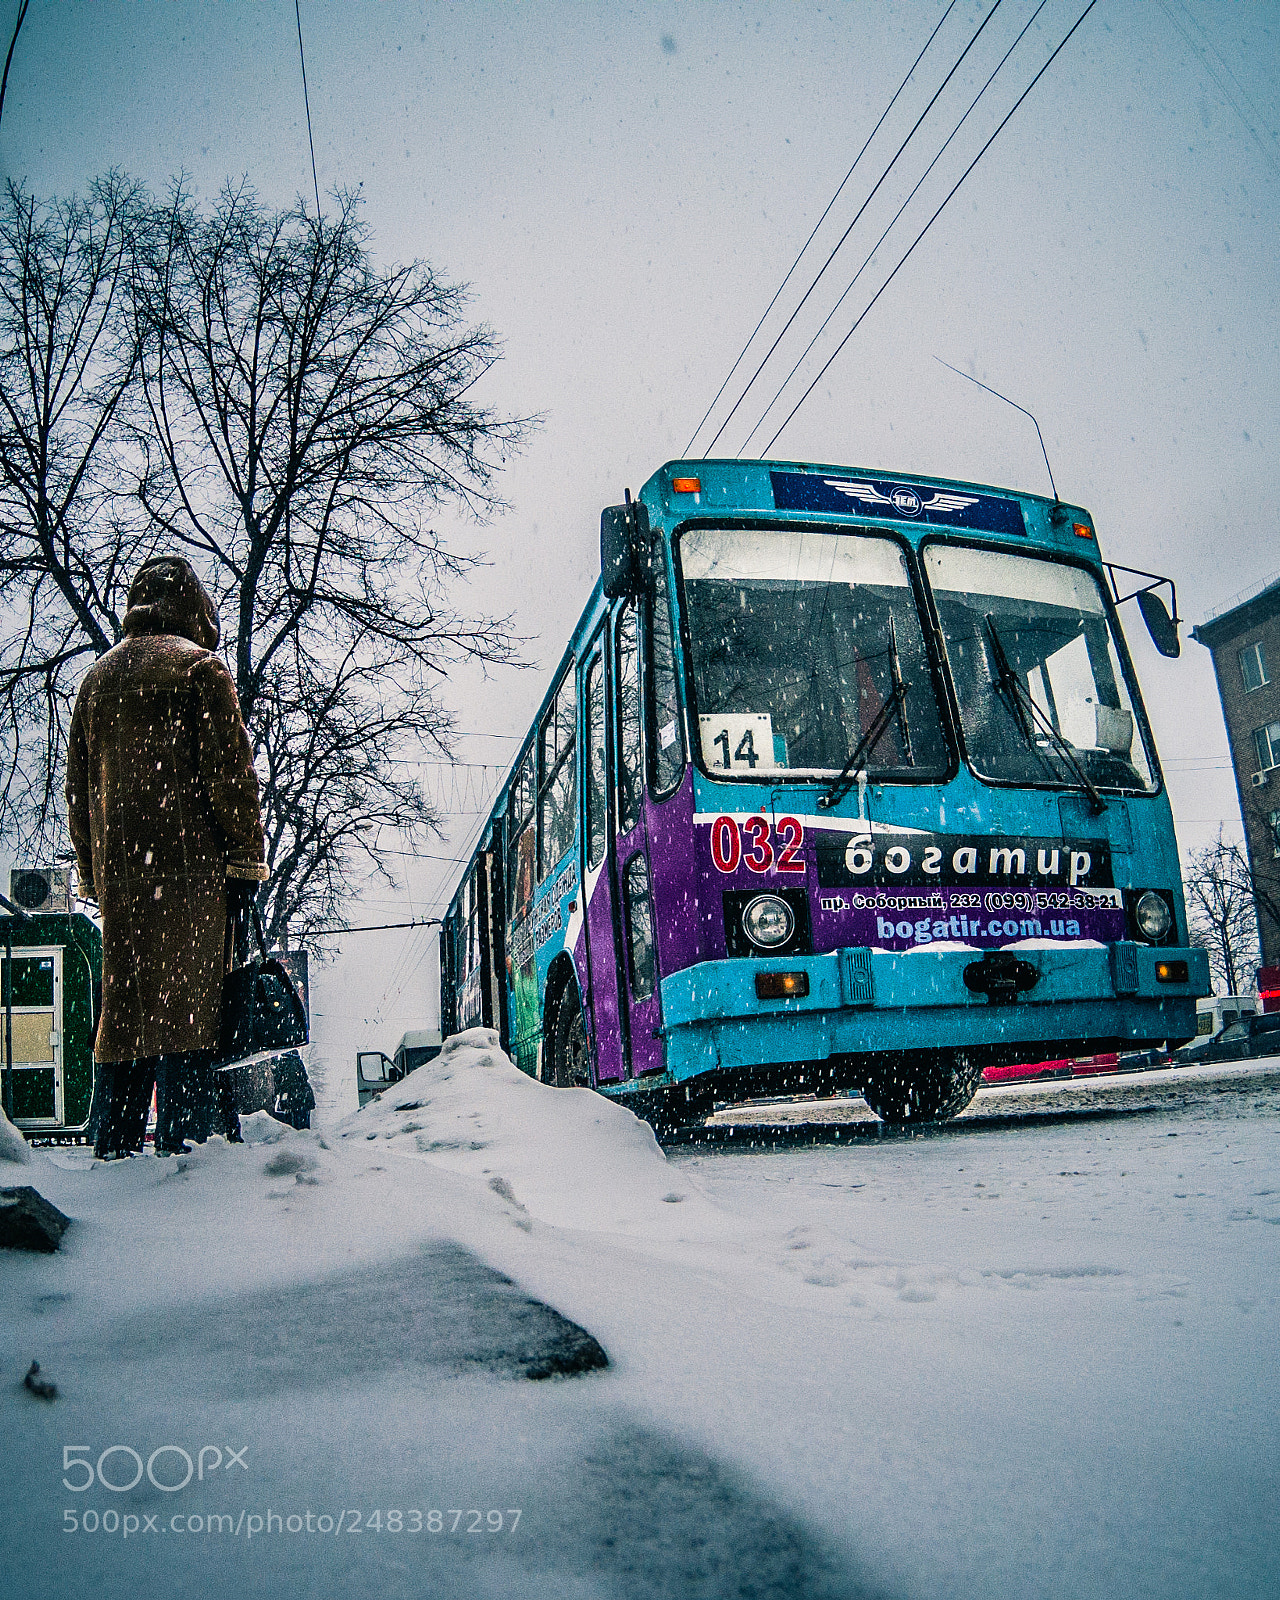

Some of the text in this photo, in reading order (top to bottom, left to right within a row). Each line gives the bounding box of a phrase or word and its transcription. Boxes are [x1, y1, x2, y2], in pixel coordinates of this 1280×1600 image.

[713, 729, 759, 769] 14
[711, 816, 806, 873] 032
[820, 892, 1120, 913] пр. Соборный, 232 (099) 542-38-21
[877, 915, 1080, 942] bogatir.com.ua
